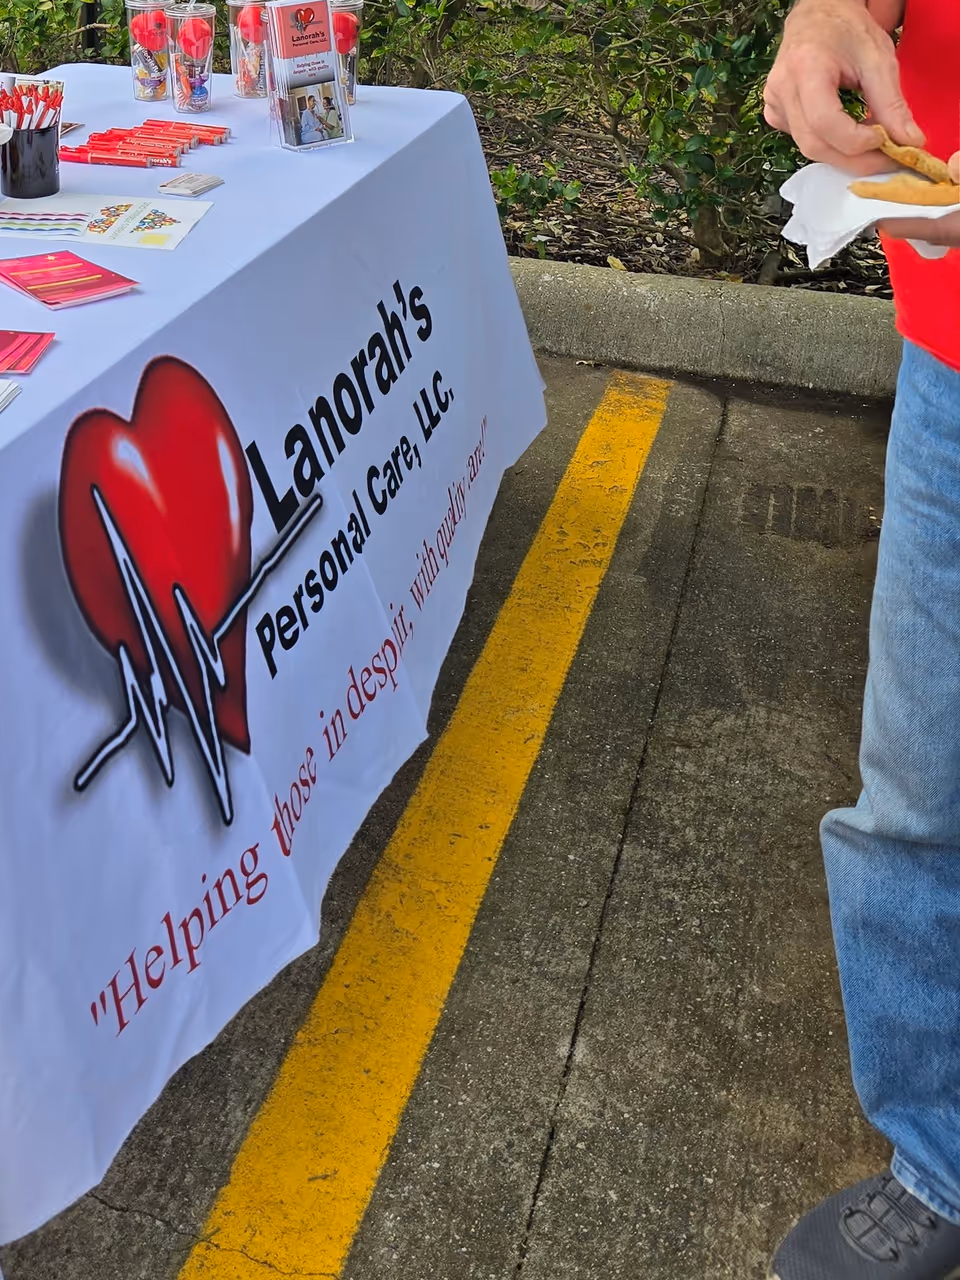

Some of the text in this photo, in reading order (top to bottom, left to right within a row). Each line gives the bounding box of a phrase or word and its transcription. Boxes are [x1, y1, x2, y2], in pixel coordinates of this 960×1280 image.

[291, 31, 325, 42] Lanorah's
[245, 279, 433, 534] Lanorah's
[255, 489, 371, 680] Personal
[366, 435, 422, 517] Care,
[90, 842, 269, 1038] "Helping
[270, 746, 318, 857] those
[319, 709, 348, 762] in
[346, 602, 415, 721] despir,
[409, 539, 440, 611] with
[436, 479, 467, 568] quality
